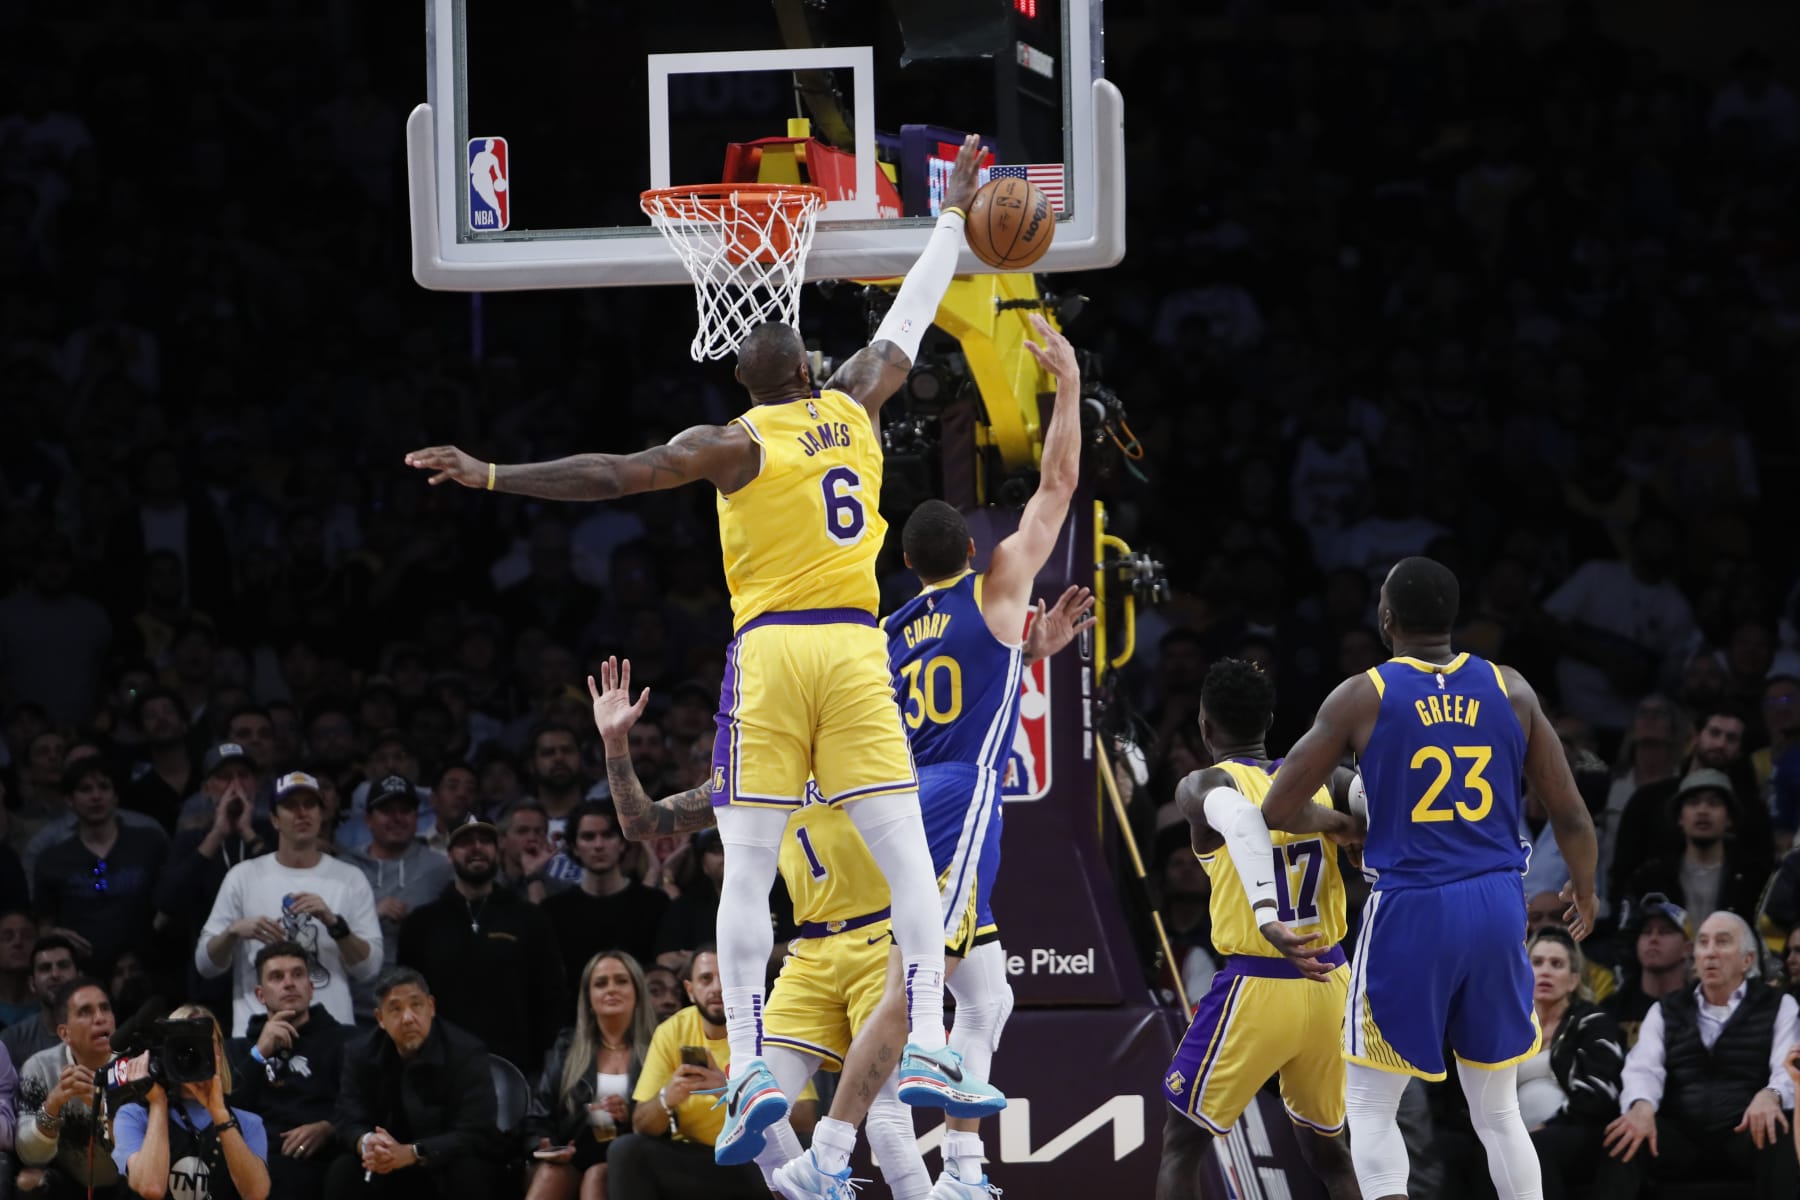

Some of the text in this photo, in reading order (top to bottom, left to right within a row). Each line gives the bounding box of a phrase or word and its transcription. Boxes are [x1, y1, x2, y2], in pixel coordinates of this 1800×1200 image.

[474, 209, 494, 226] NBA
[796, 422, 851, 457] JAMES
[820, 465, 867, 546] 6
[903, 612, 951, 649] CURRY
[900, 655, 962, 729] 30
[1414, 694, 1481, 727] GREEN
[1410, 745, 1494, 823] 23
[796, 825, 828, 883] 1
[1272, 839, 1325, 928] 17
[1031, 947, 1095, 975] Pixel
[170, 1171, 209, 1191] TNT
